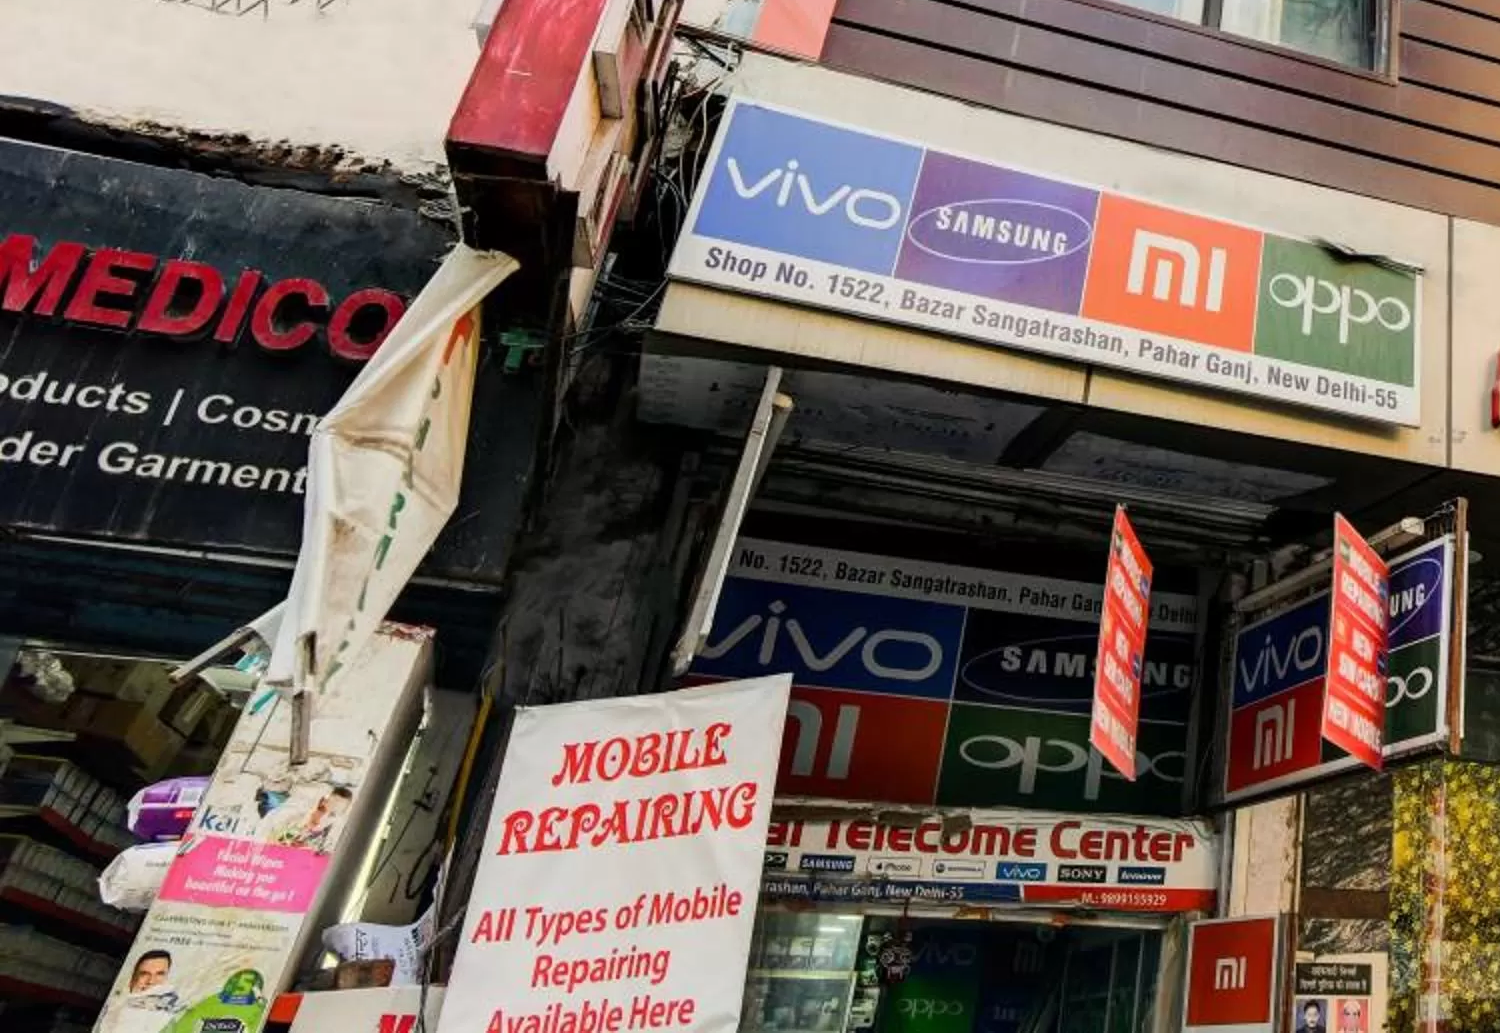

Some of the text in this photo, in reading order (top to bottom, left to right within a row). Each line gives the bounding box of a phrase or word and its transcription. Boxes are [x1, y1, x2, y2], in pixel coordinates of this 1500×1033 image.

[727, 157, 901, 230] vivo
[935, 207, 1068, 256] SAMSUNG
[705, 246, 1398, 410] Shop No. 1522, Bazar Sangatrashan, Pahar Ganj, New Delhi-55
[1268, 273, 1411, 345] oppo
[739, 549, 770, 570] No.
[779, 555, 831, 581] 1522,
[835, 562, 887, 585] Bazar
[890, 569, 1013, 603] Sangatrashan,
[1019, 587, 1067, 609] Pahar
[1000, 646, 1193, 689] SAMNG
[1239, 624, 1324, 695] vivo
[551, 722, 732, 787] MOBILE
[496, 783, 758, 855] REPAIRING
[1050, 820, 1195, 862] Center
[1002, 865, 1041, 879] vivo
[1060, 868, 1104, 879] SONY
[471, 883, 743, 948] All Types of Mobile
[530, 945, 671, 994] Repairing
[485, 995, 696, 1033] Available Here
